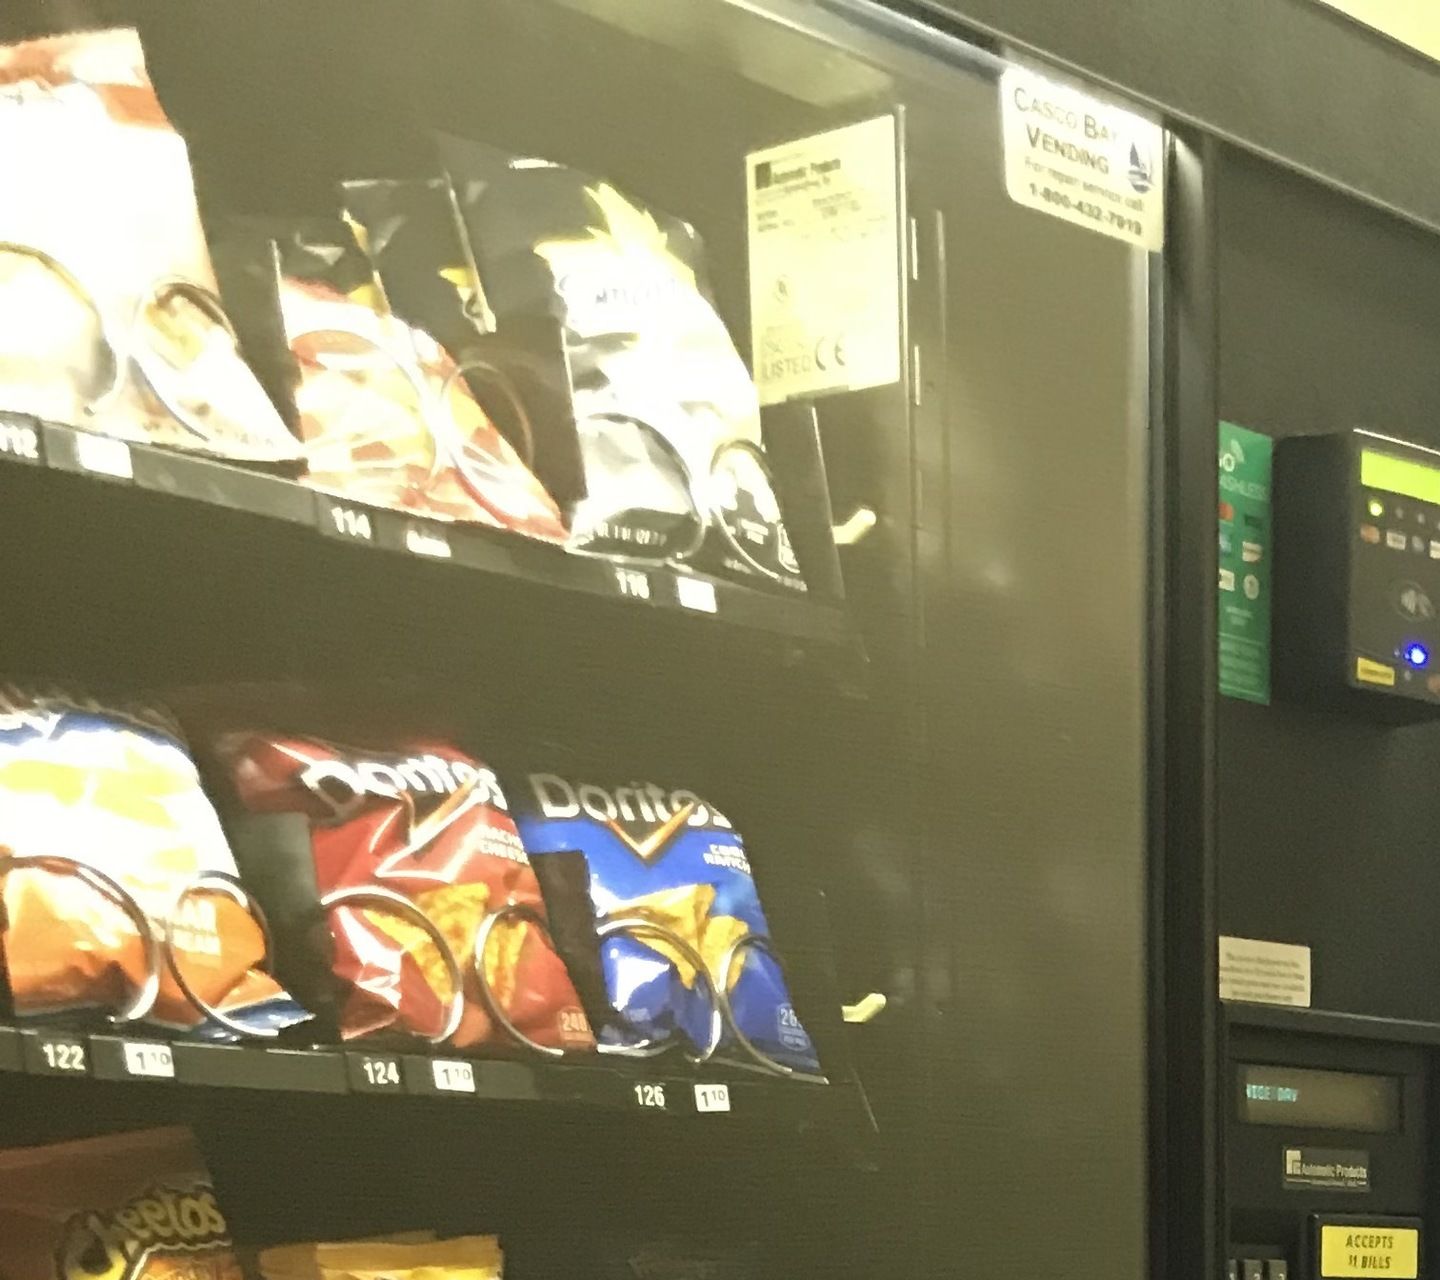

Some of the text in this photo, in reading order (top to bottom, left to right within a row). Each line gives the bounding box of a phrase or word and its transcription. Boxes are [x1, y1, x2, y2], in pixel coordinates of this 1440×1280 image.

[1026, 123, 1109, 175] VENDING
[528, 772, 733, 830] Doritos
[43, 1043, 86, 1071] 122
[363, 1061, 400, 1084] 124
[635, 1083, 666, 1107] 126
[1345, 1234, 1394, 1249] ACCEPTS
[1361, 1255, 1391, 1270] BILLS
